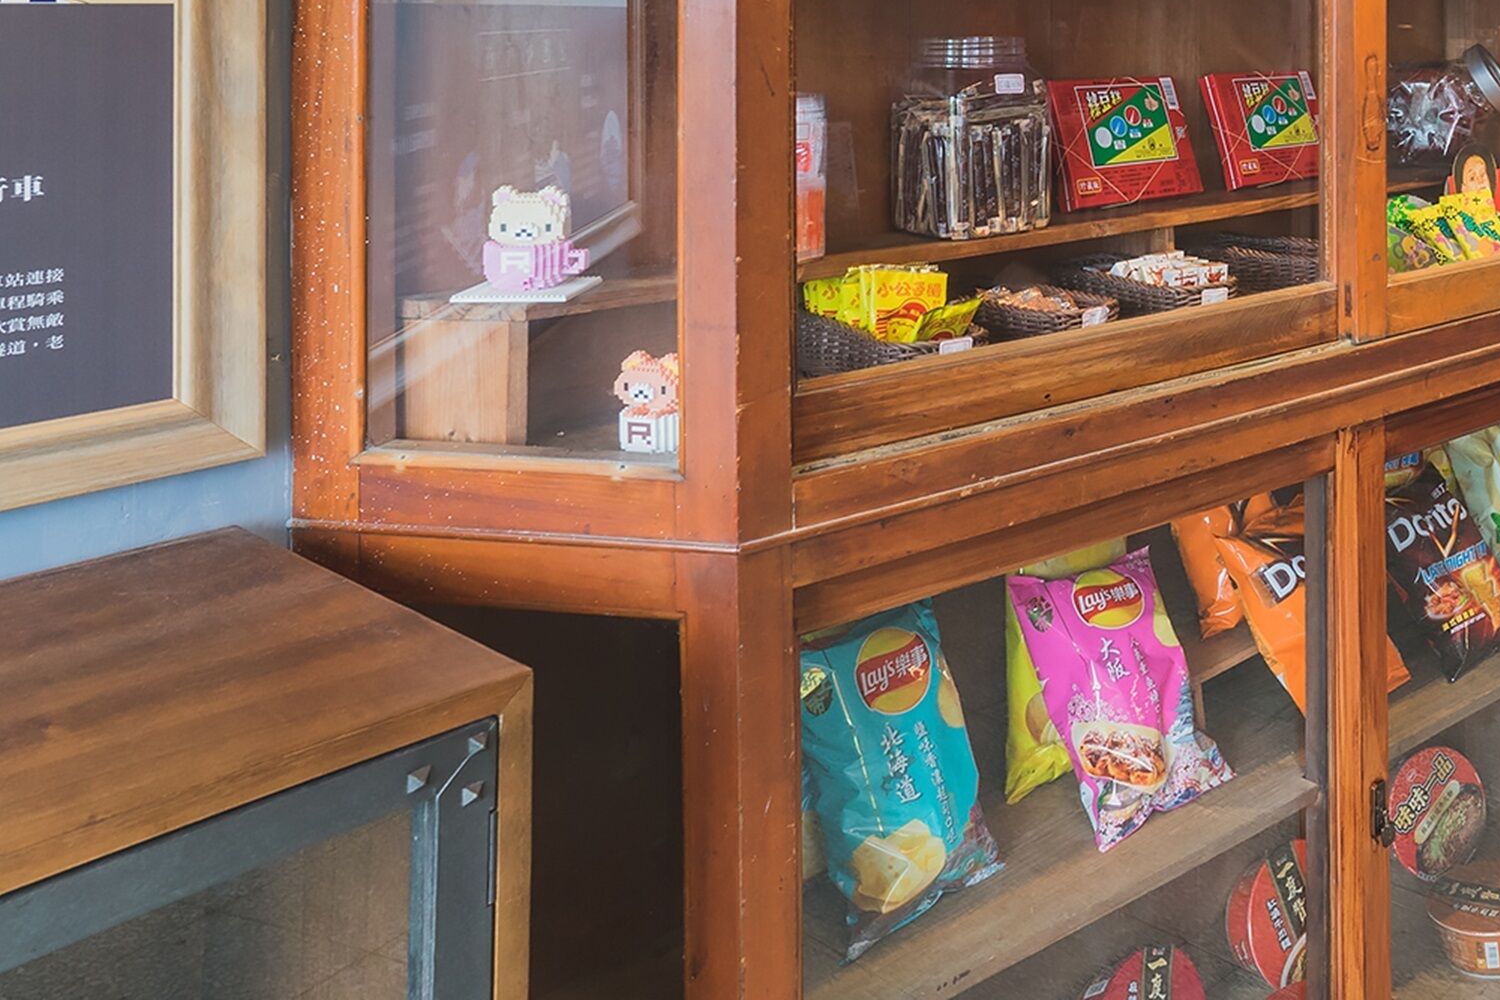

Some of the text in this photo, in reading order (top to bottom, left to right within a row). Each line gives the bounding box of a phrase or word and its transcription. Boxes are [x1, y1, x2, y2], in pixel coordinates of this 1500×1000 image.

[0, 267, 65, 288] 站連接
[0, 289, 65, 312] 程騎乘
[627, 421, 652, 445] R
[1077, 582, 1139, 615] Lay's 樂事
[860, 643, 928, 696] Lay's 樂事
[1100, 636, 1131, 683] 大阪
[880, 721, 922, 804] 北海道
[1392, 750, 1456, 834] 味味一品
